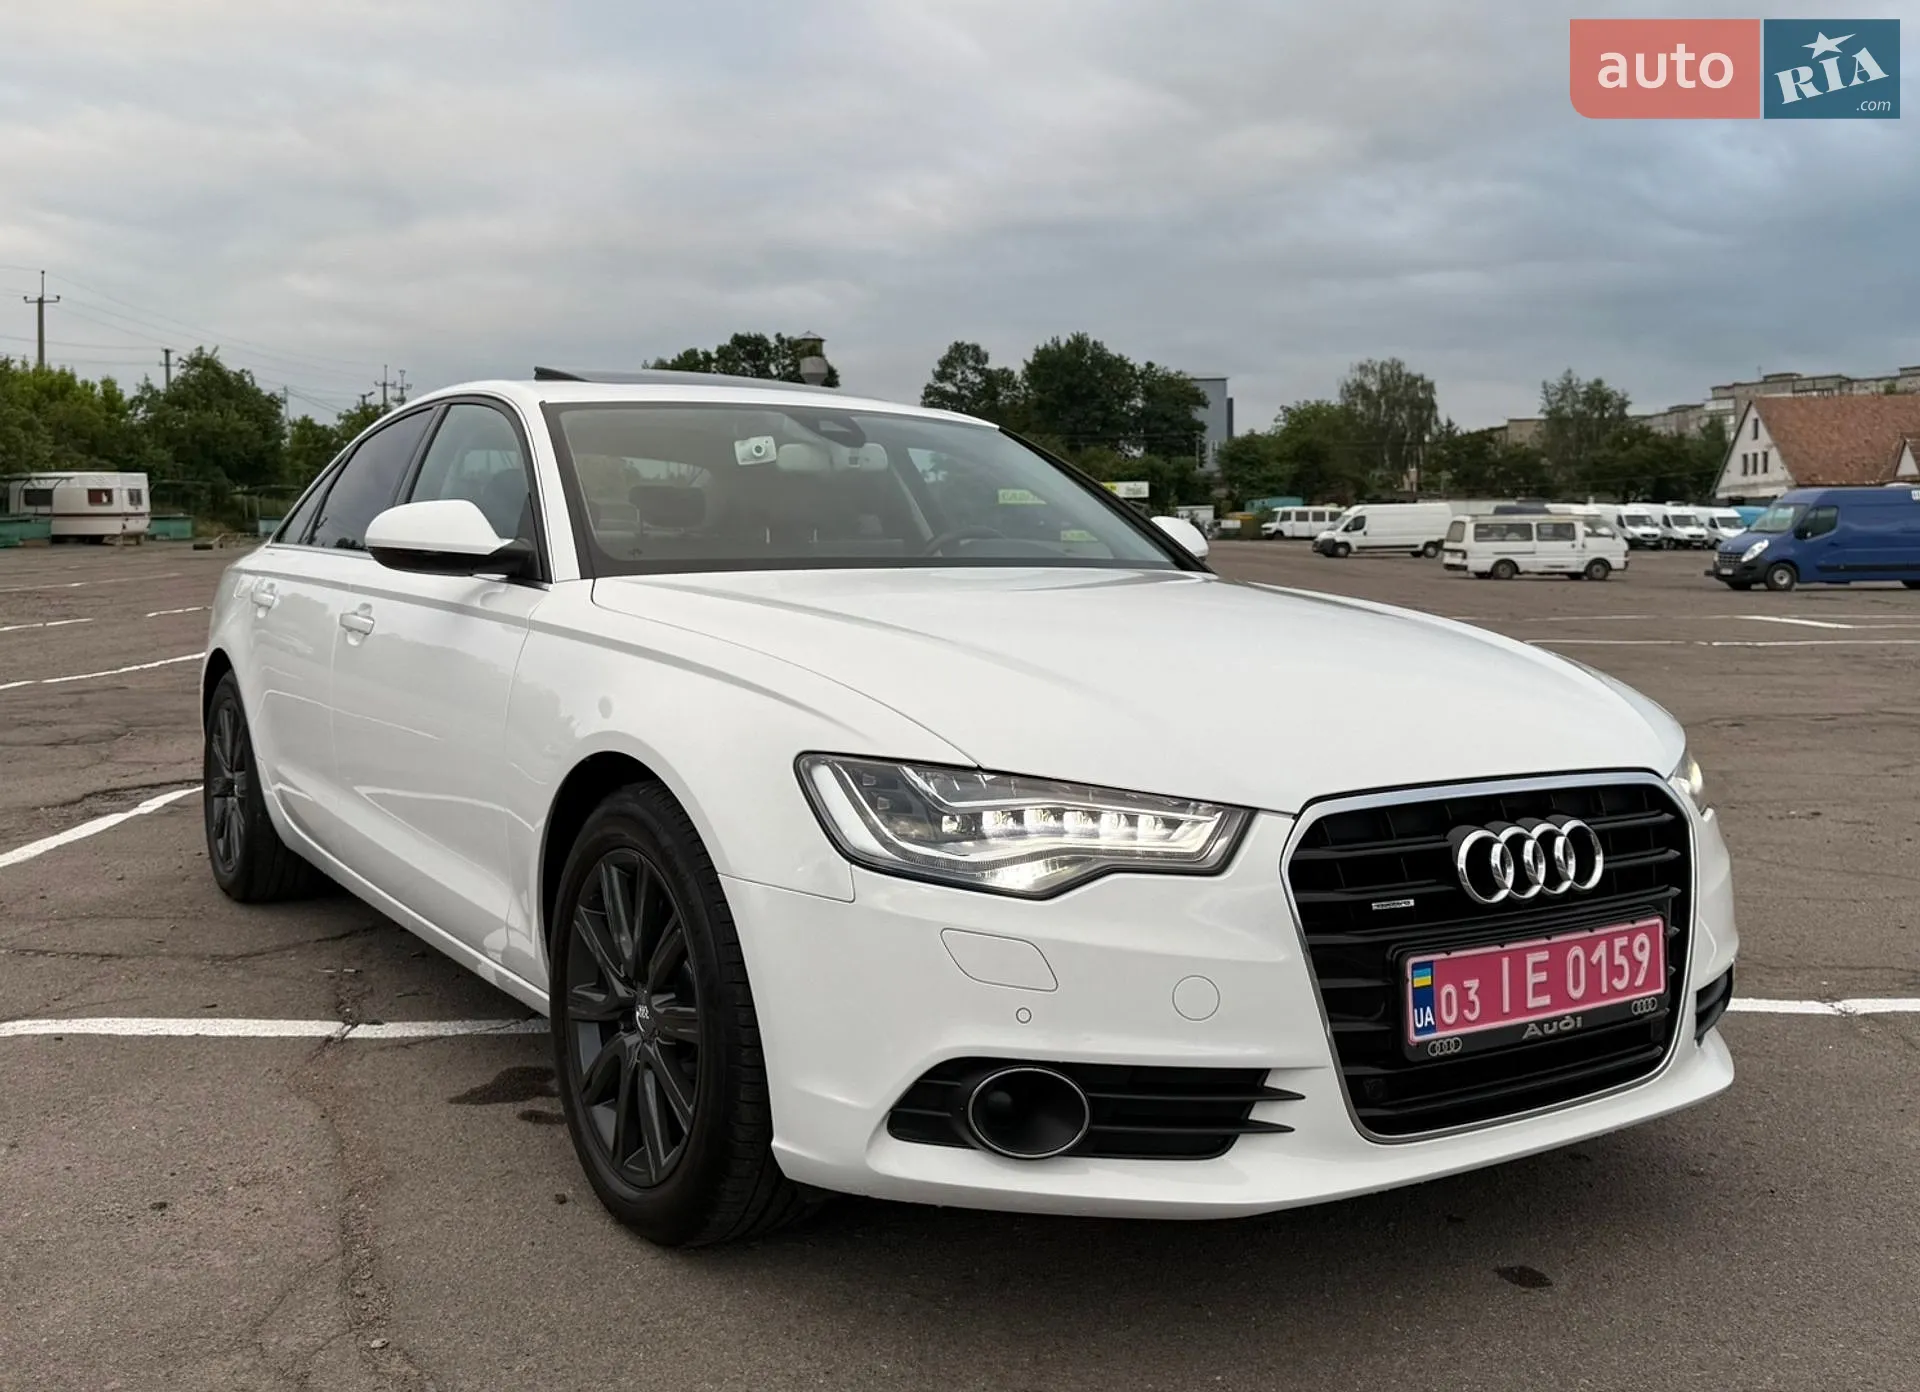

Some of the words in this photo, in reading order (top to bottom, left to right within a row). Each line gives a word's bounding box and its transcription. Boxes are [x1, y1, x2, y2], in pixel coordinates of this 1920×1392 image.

[1414, 1006, 1435, 1028] UA
[1440, 979, 1480, 1025] 03
[1502, 951, 1551, 1013] IE
[1567, 933, 1651, 1000] 0159
[1522, 1015, 1583, 1040] Audi
